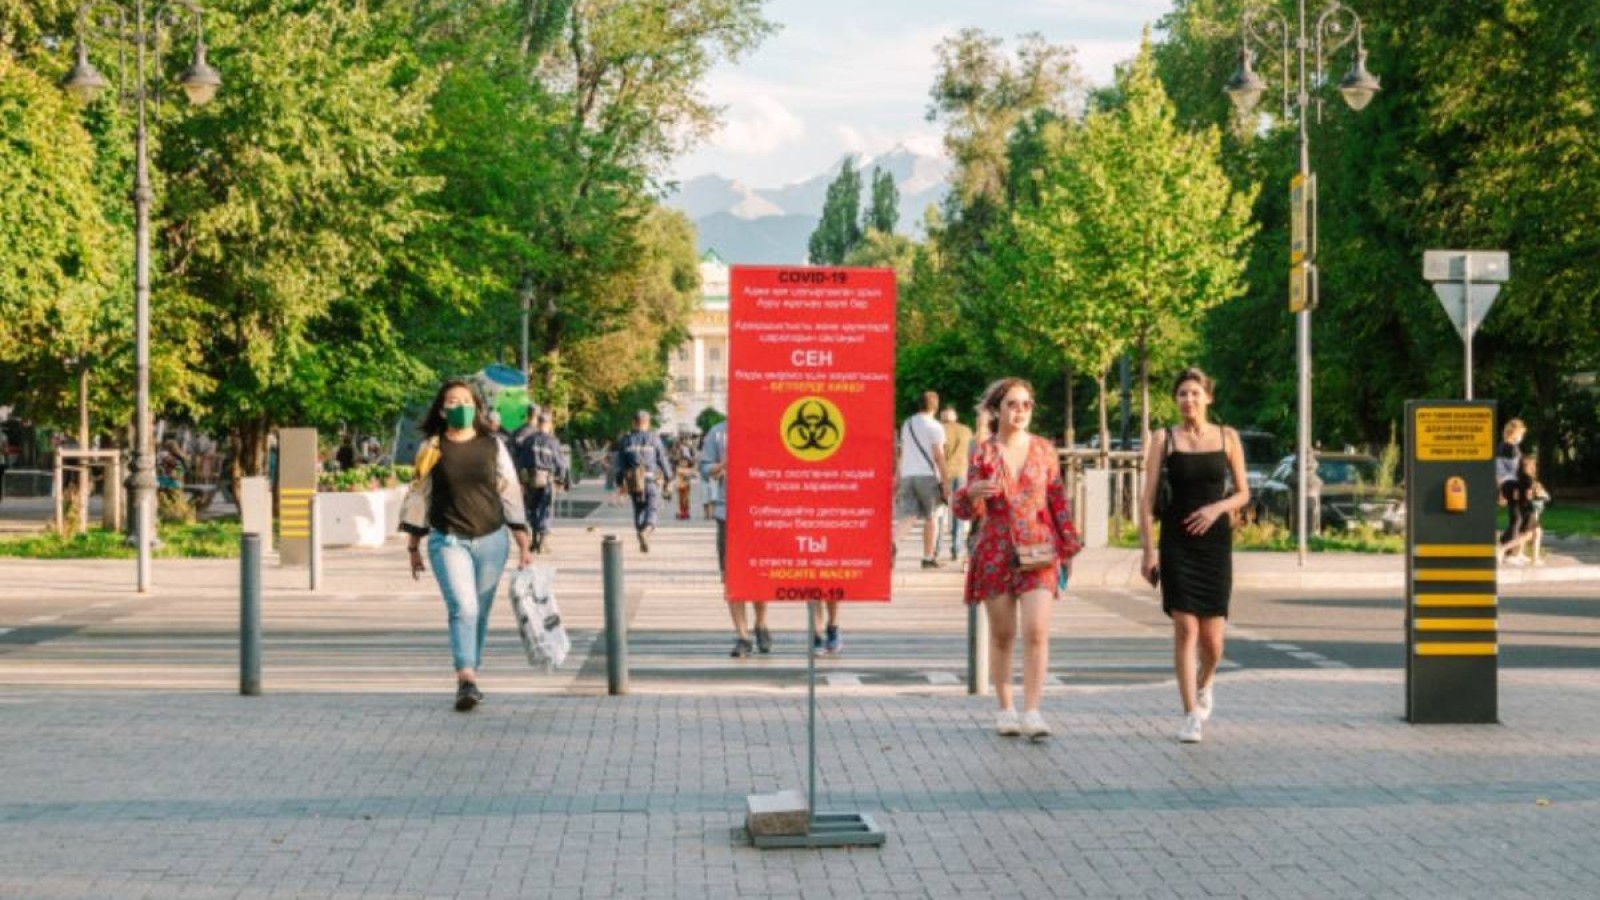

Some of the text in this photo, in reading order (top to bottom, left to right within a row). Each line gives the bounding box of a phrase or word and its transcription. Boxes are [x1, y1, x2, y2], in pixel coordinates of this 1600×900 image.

[778, 271, 848, 284] COVID-19
[791, 350, 833, 367] СЕН
[776, 587, 845, 601] COVID-19
